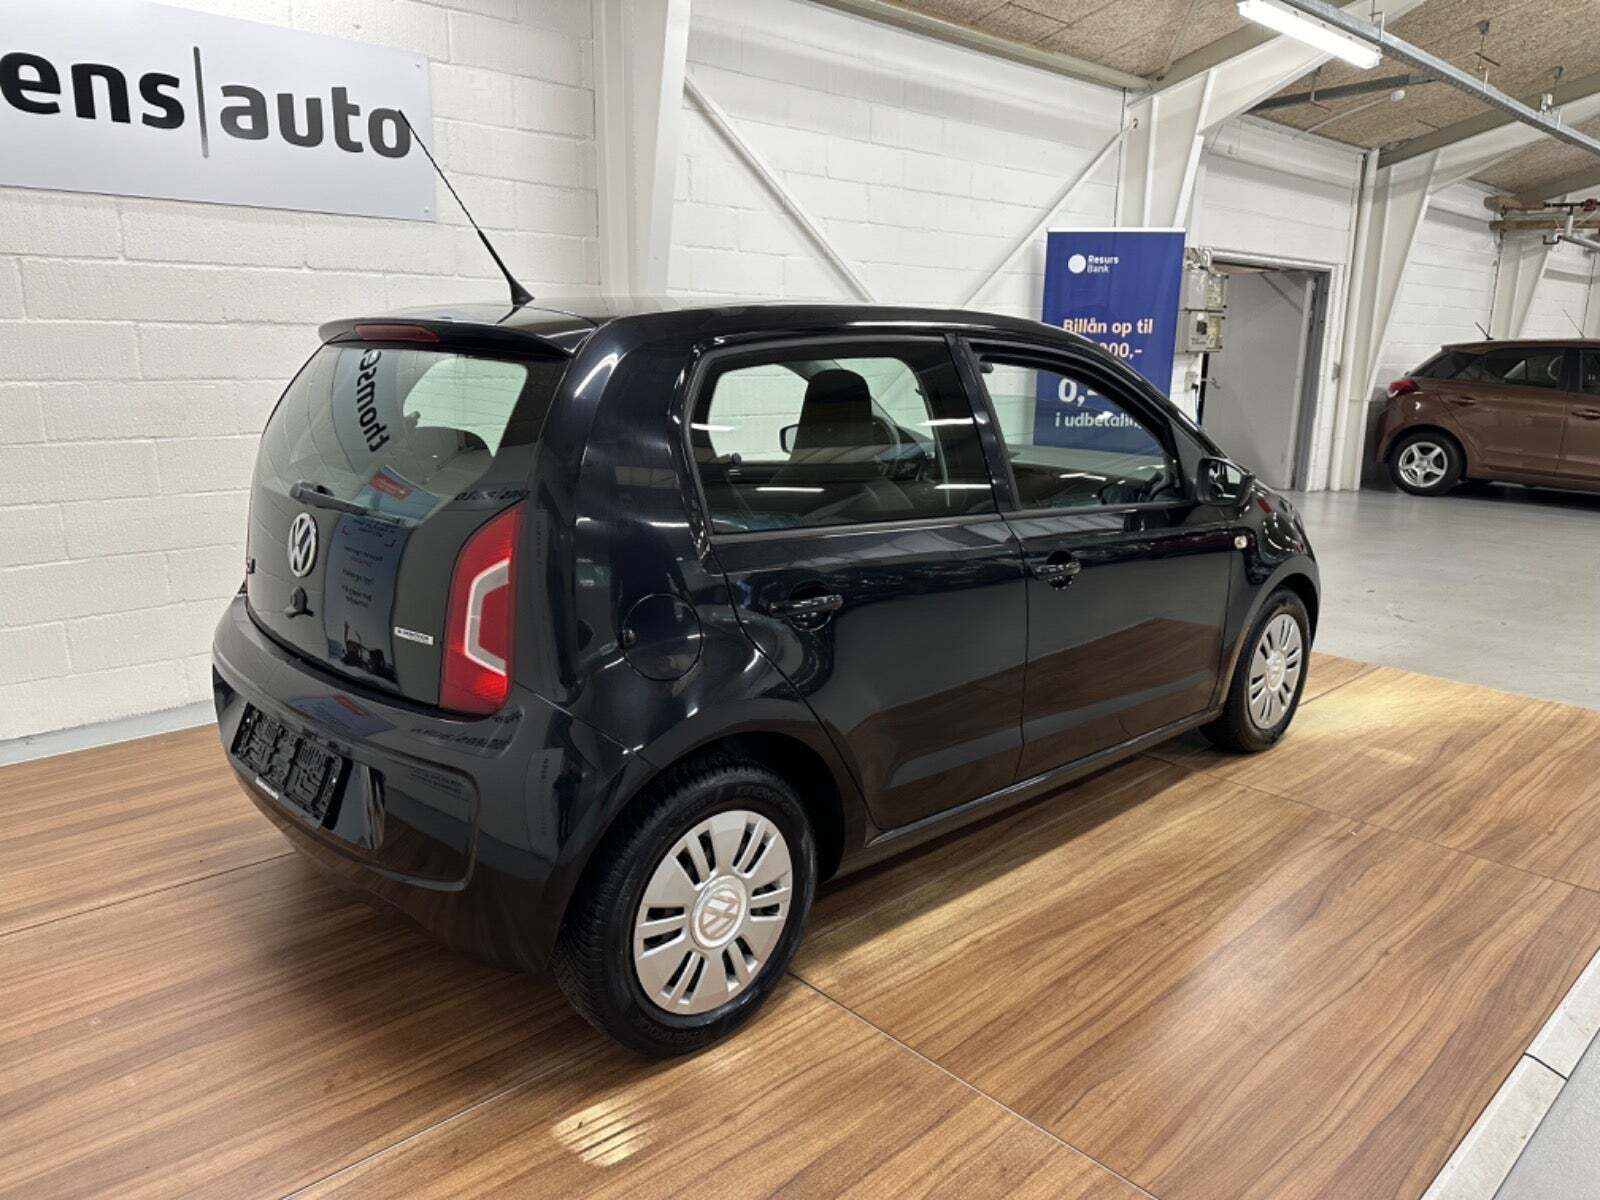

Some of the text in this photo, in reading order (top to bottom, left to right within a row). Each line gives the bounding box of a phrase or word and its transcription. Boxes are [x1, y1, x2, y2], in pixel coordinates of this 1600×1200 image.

[220, 85, 411, 158] auto
[1088, 254, 1119, 265] Resurs
[1087, 264, 1109, 273] Bank
[1063, 317, 1153, 337] Billån op til
[1055, 412, 1061, 427] i
